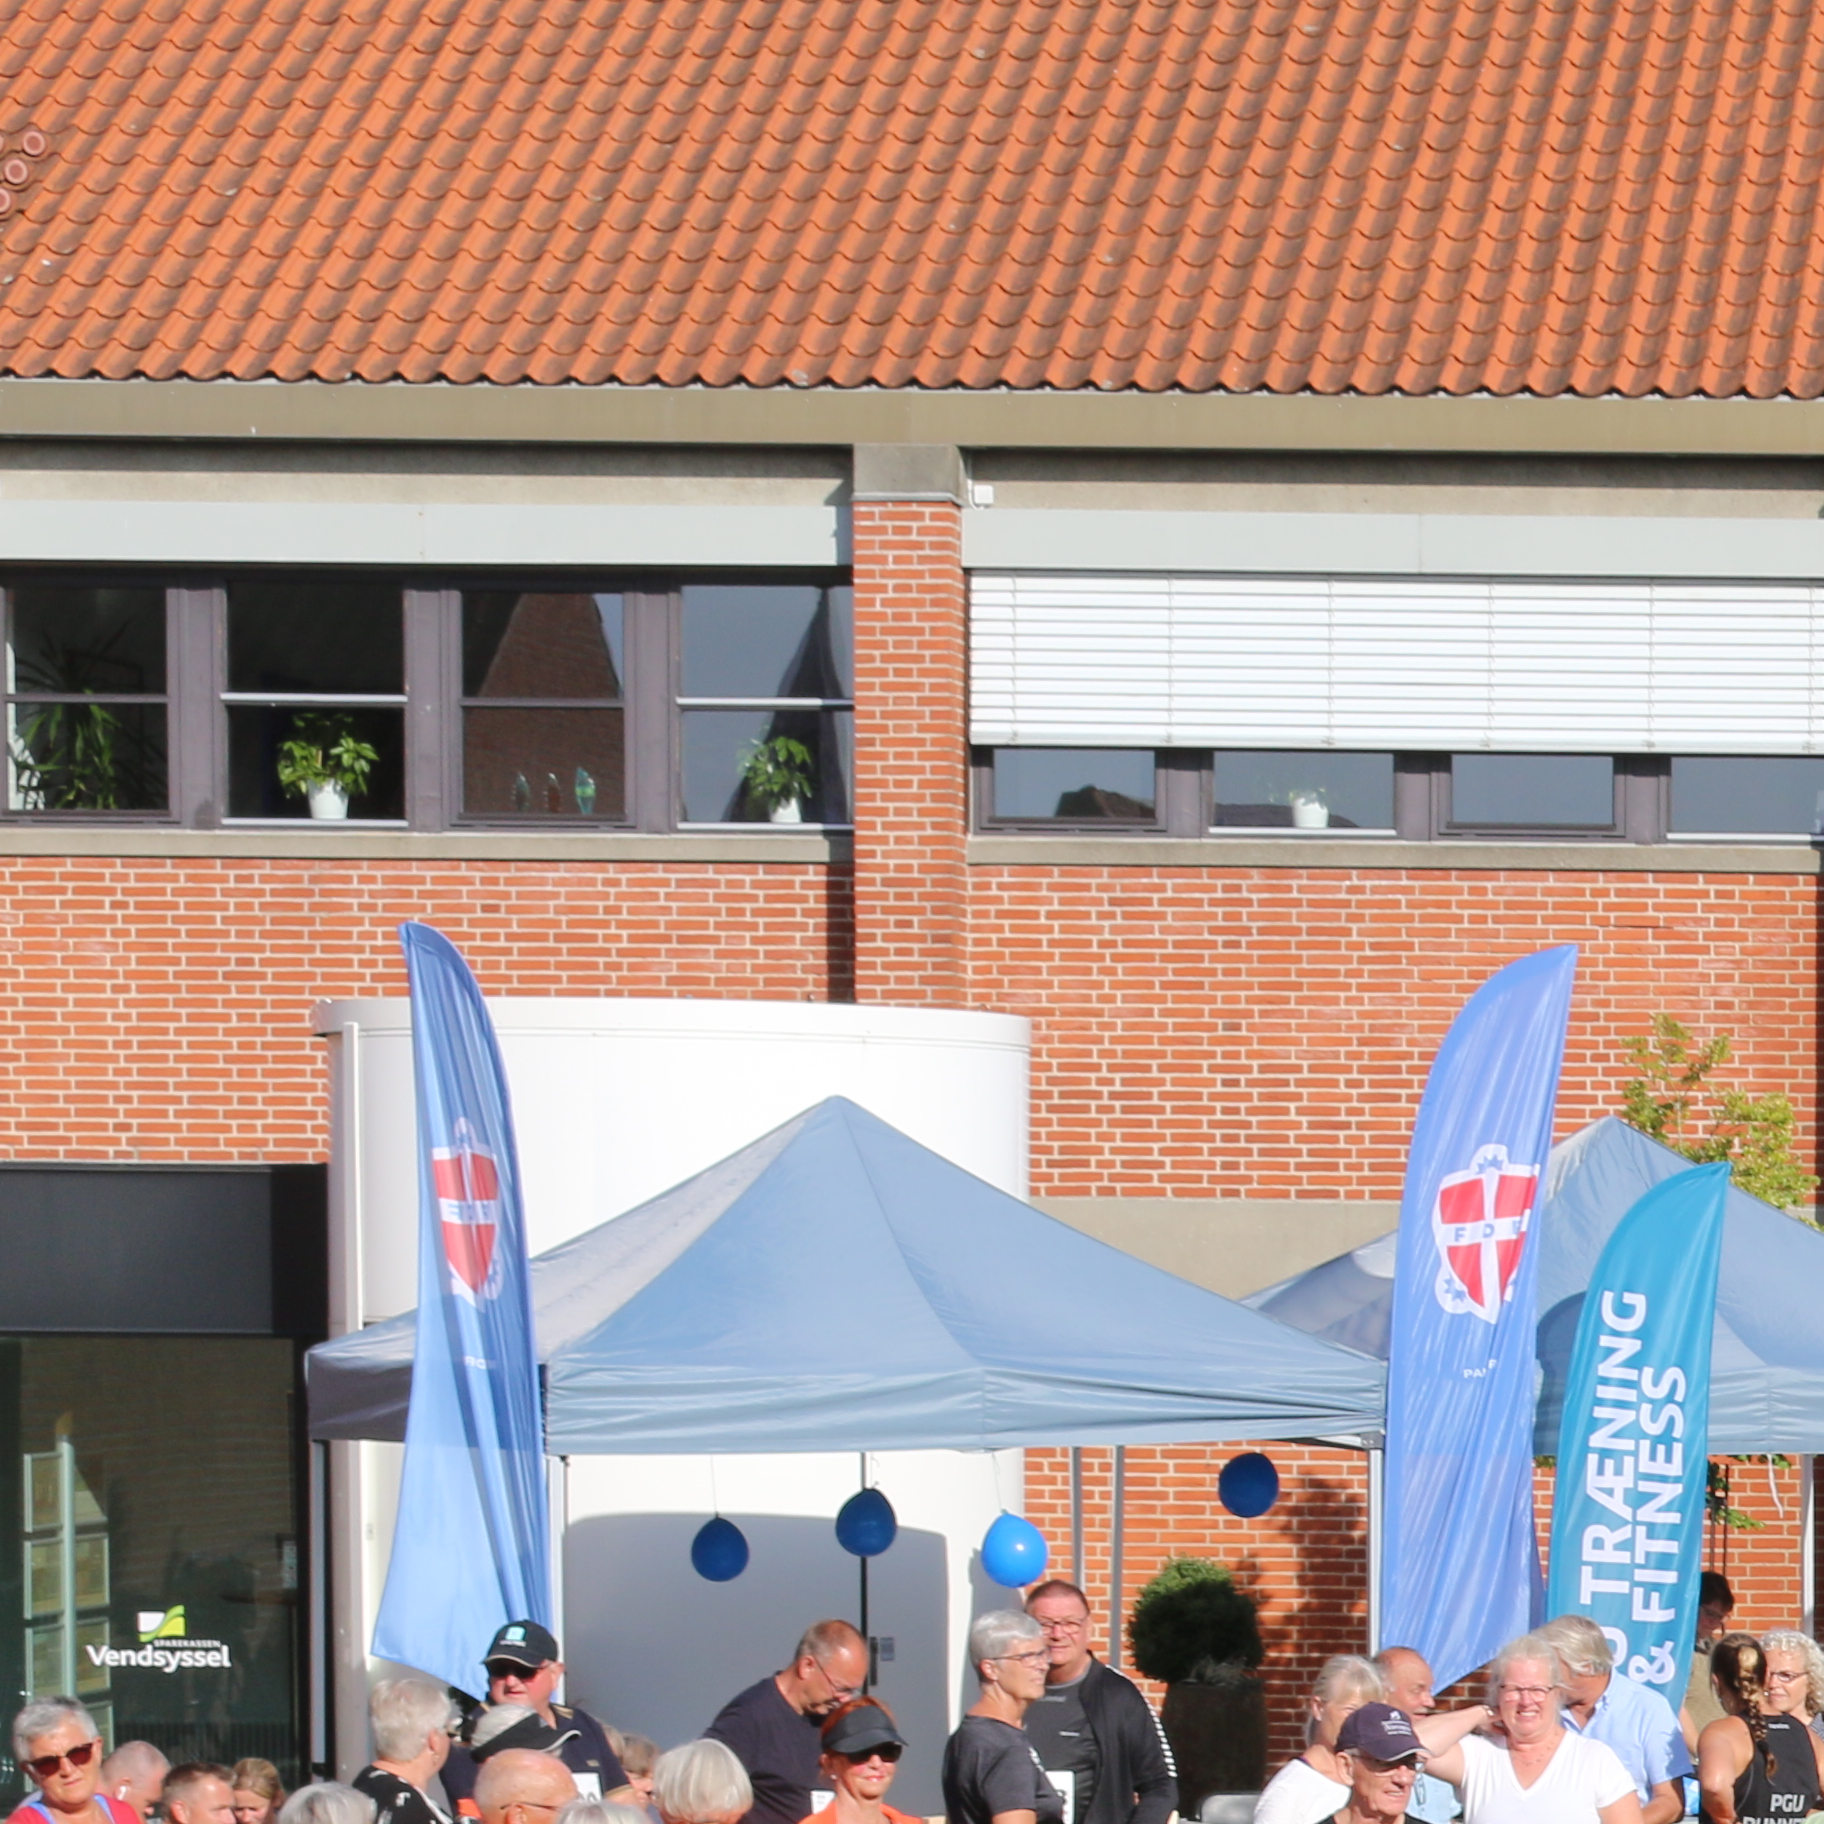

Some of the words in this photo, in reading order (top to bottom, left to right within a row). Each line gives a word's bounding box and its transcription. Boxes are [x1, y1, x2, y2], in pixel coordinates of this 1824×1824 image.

[1580, 1290, 1648, 1604] TRÆNING
[1631, 1365, 1688, 1623] FITNESS
[153, 1639, 221, 1648] SPAREKASSEN
[85, 1644, 231, 1673] Vendsyssel
[1770, 1794, 1806, 1813] PGU
